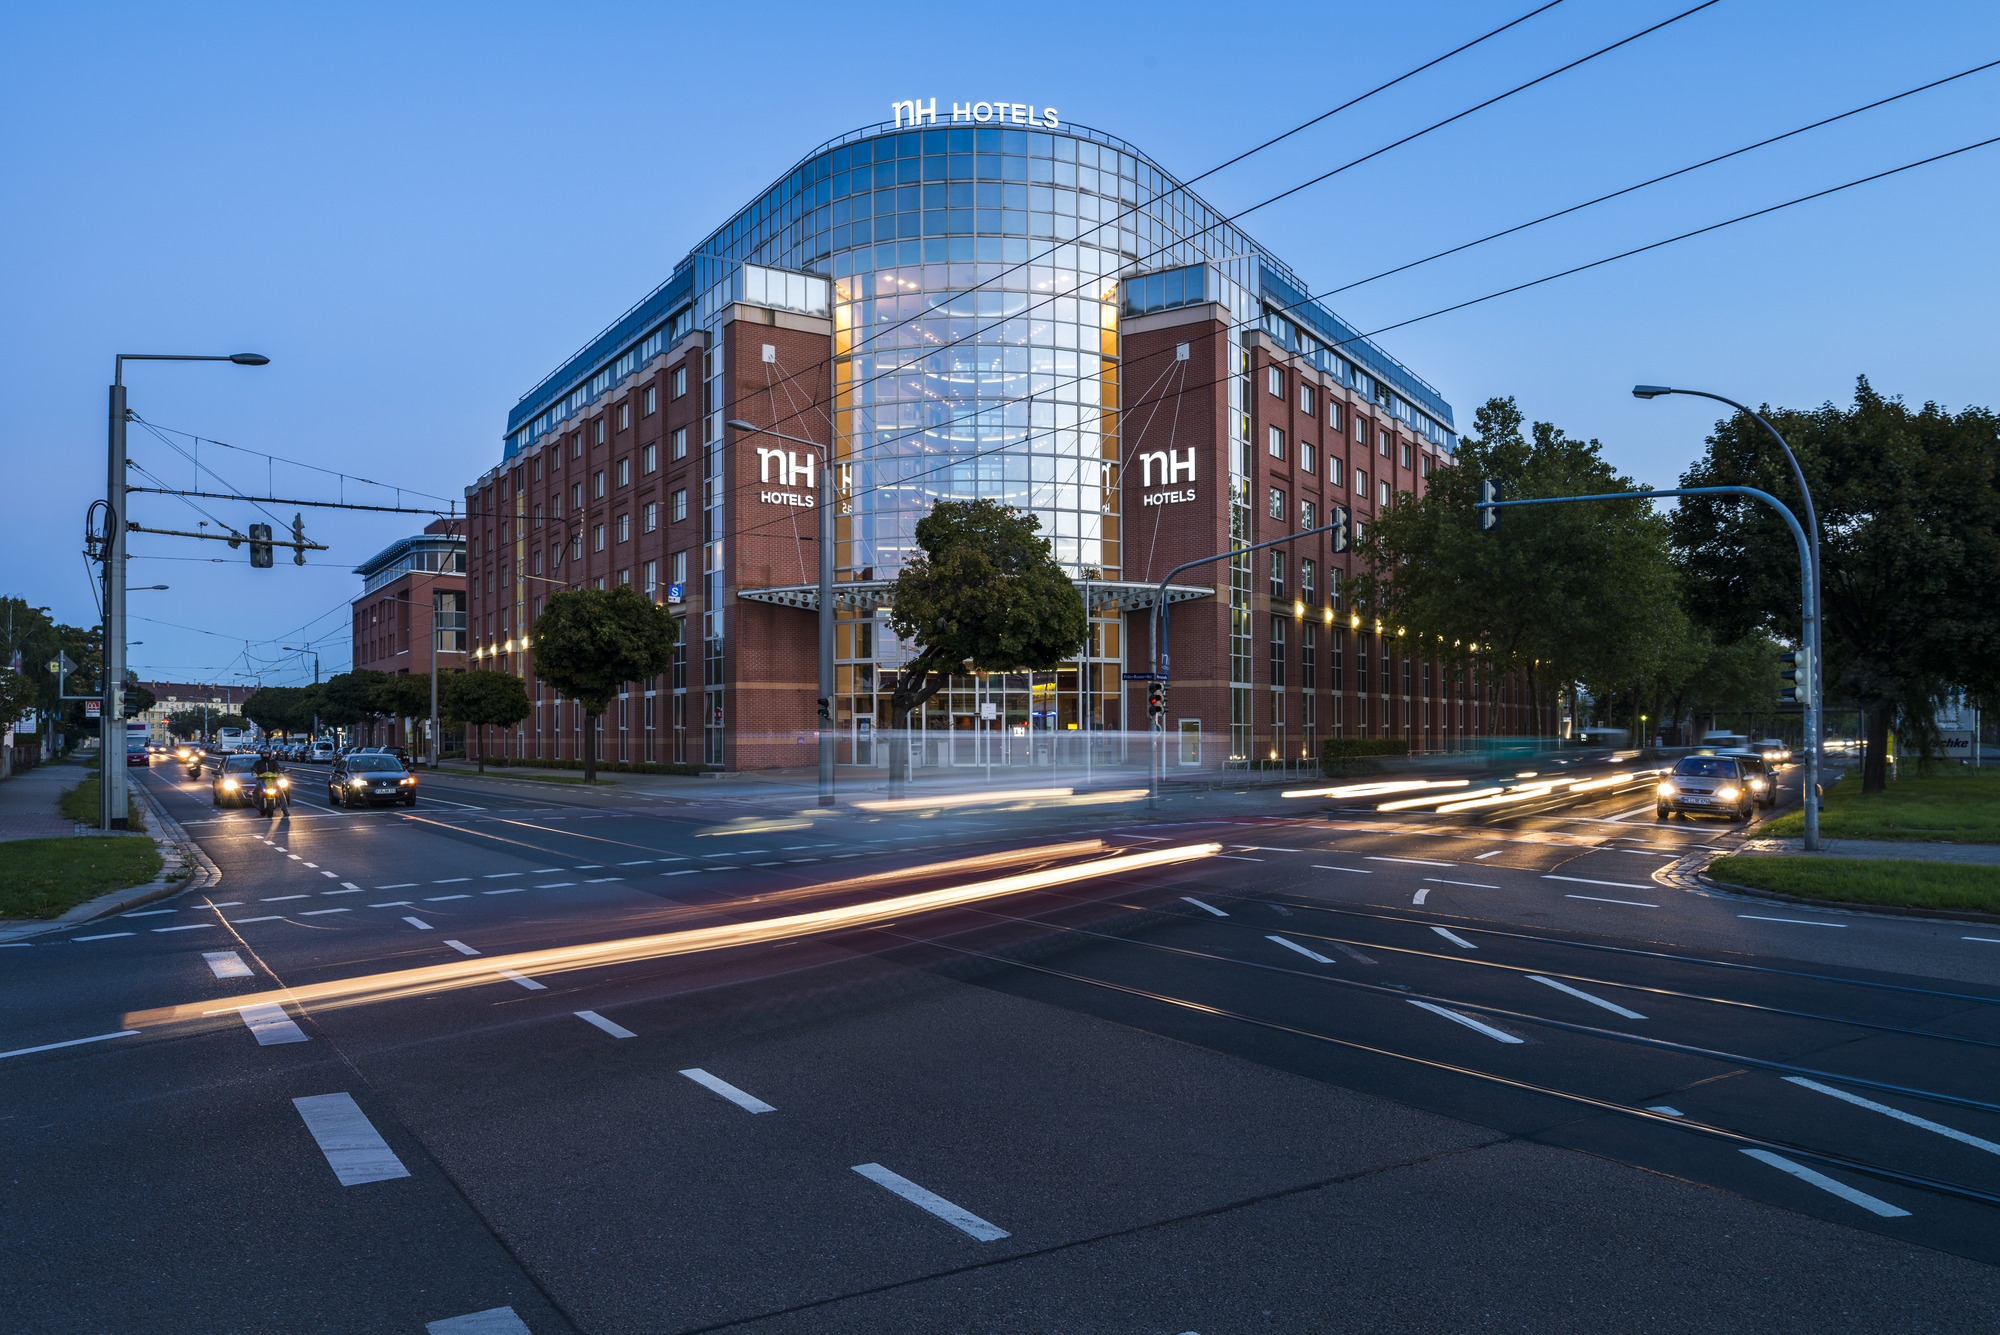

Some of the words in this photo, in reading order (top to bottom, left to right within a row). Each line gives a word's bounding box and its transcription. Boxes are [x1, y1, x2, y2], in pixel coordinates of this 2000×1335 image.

[953, 101, 1059, 128] HOTELS
[761, 490, 814, 508] HOTELS
[1143, 489, 1196, 507] HOTELS
